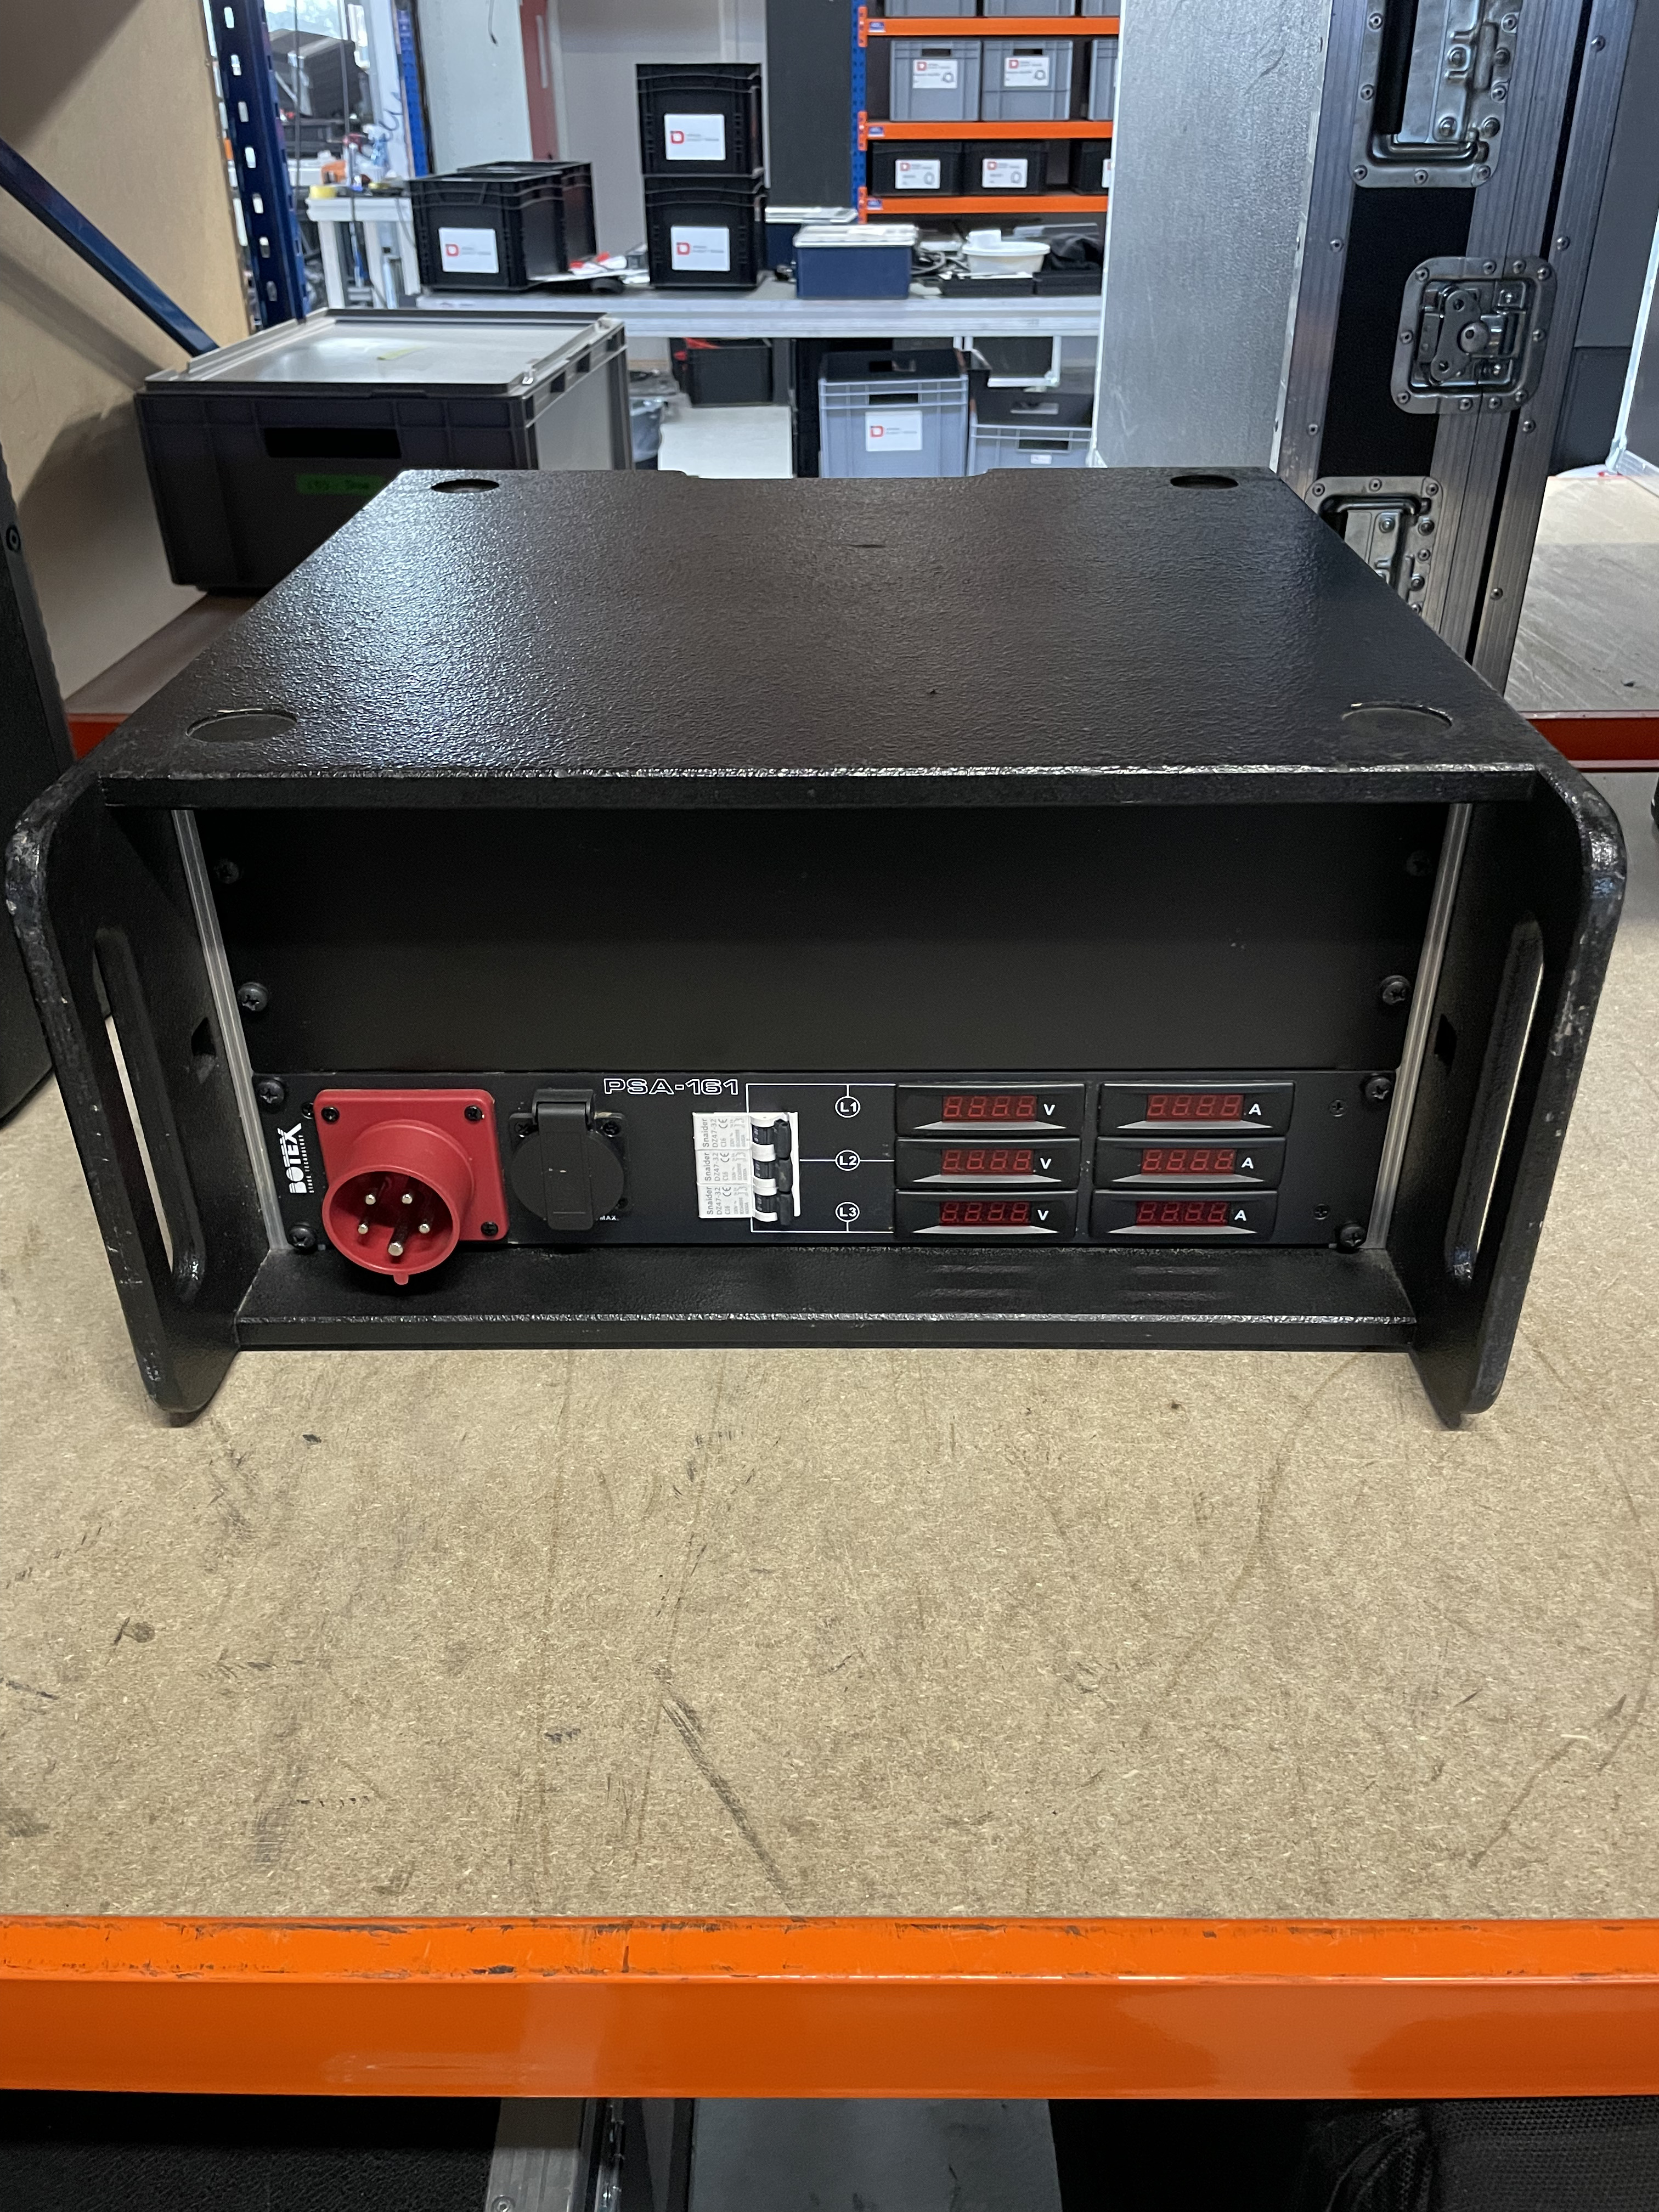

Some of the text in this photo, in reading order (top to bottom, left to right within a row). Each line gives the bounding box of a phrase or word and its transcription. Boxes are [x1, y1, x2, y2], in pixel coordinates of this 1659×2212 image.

[603, 1078, 738, 1095] PSA-161
[840, 1102, 856, 1113] L1
[1043, 1104, 1056, 1116] V
[1248, 1103, 1262, 1116] A
[701, 1118, 709, 1148] Snaider
[277, 1122, 307, 1193] BOTEX
[839, 1155, 857, 1166] L2
[1241, 1157, 1254, 1170] A
[703, 1152, 712, 1181] Snaider
[1040, 1158, 1052, 1170] V
[706, 1187, 714, 1215] Snaider
[839, 1207, 857, 1217] L3
[1037, 1209, 1049, 1221] V
[1234, 1210, 1247, 1222] A
